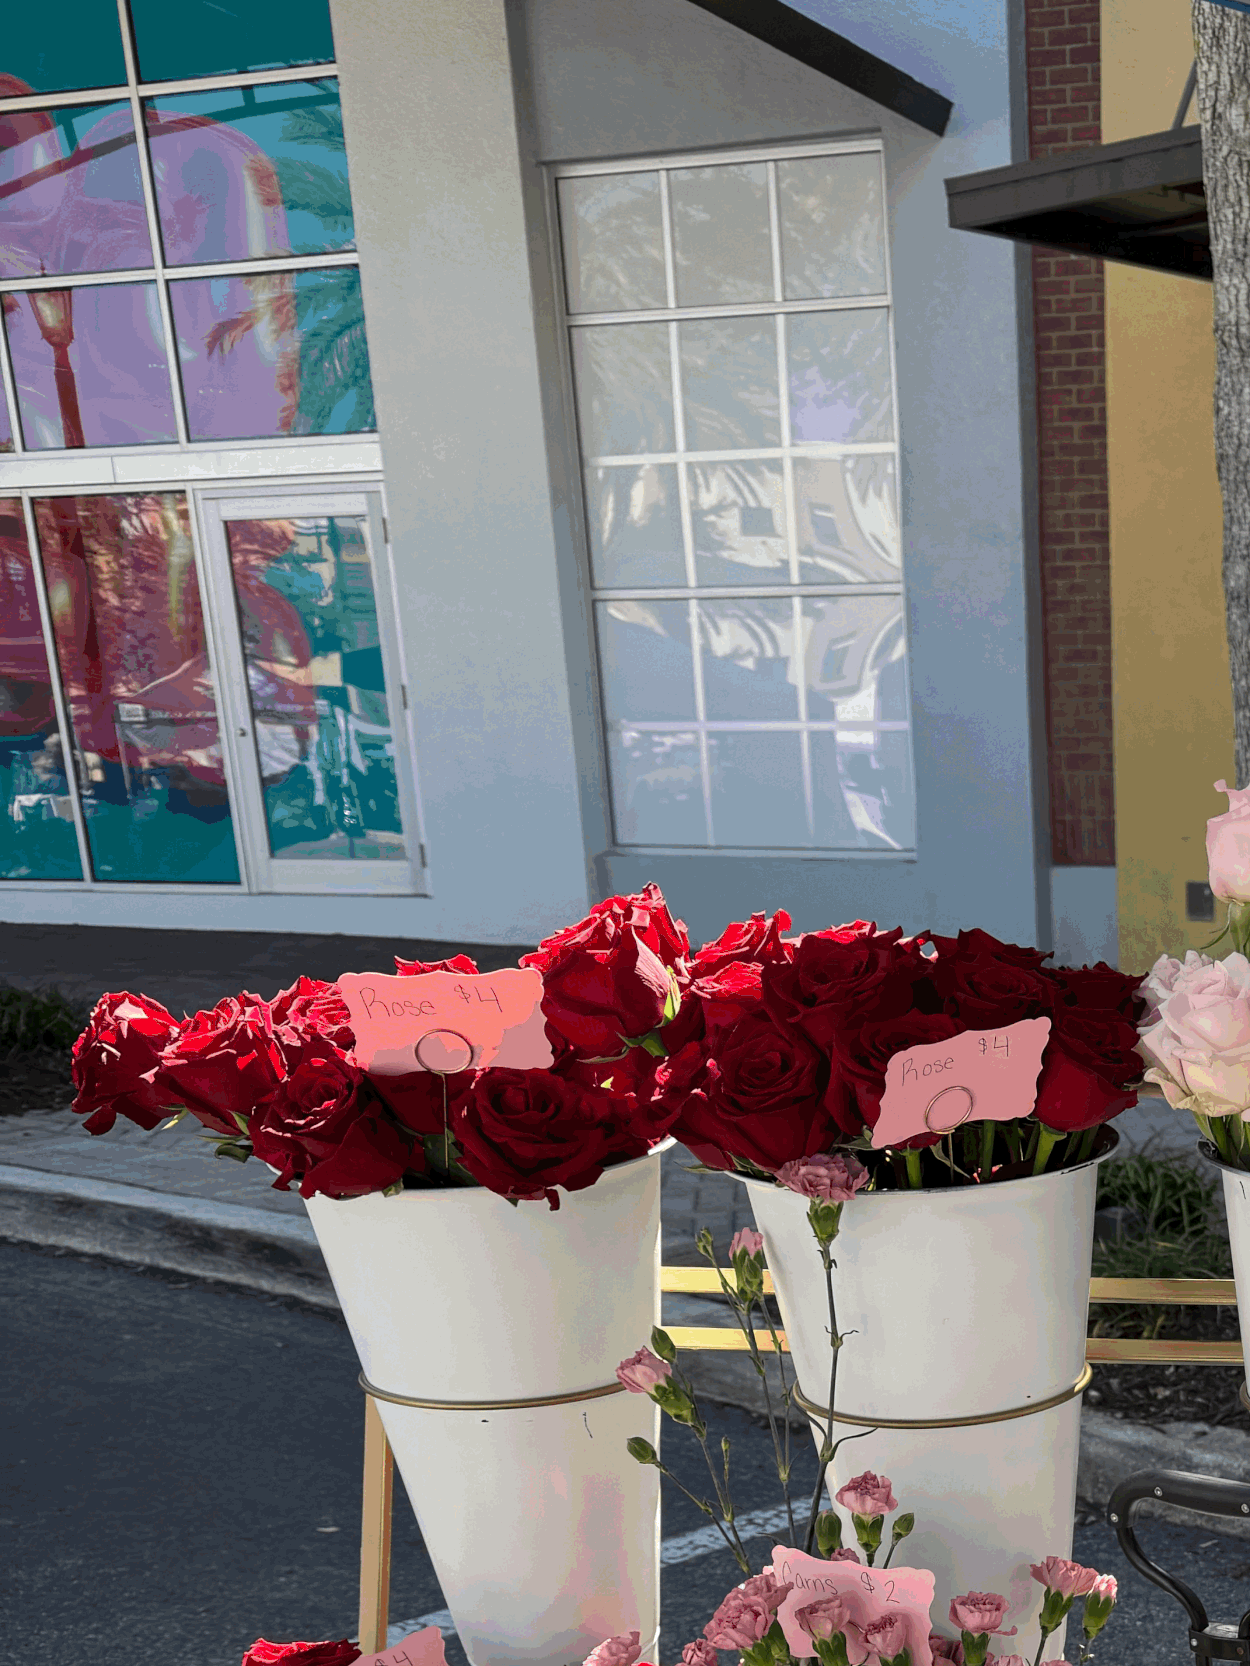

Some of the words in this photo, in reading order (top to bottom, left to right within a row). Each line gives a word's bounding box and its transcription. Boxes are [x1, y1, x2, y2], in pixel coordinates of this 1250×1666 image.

[359, 986, 437, 1019] Rose
[453, 983, 503, 1013] $4
[901, 1056, 955, 1087] Rose
[977, 1035, 1010, 1058] $4
[781, 1560, 839, 1595] Carns
[860, 1571, 900, 1604] $2
